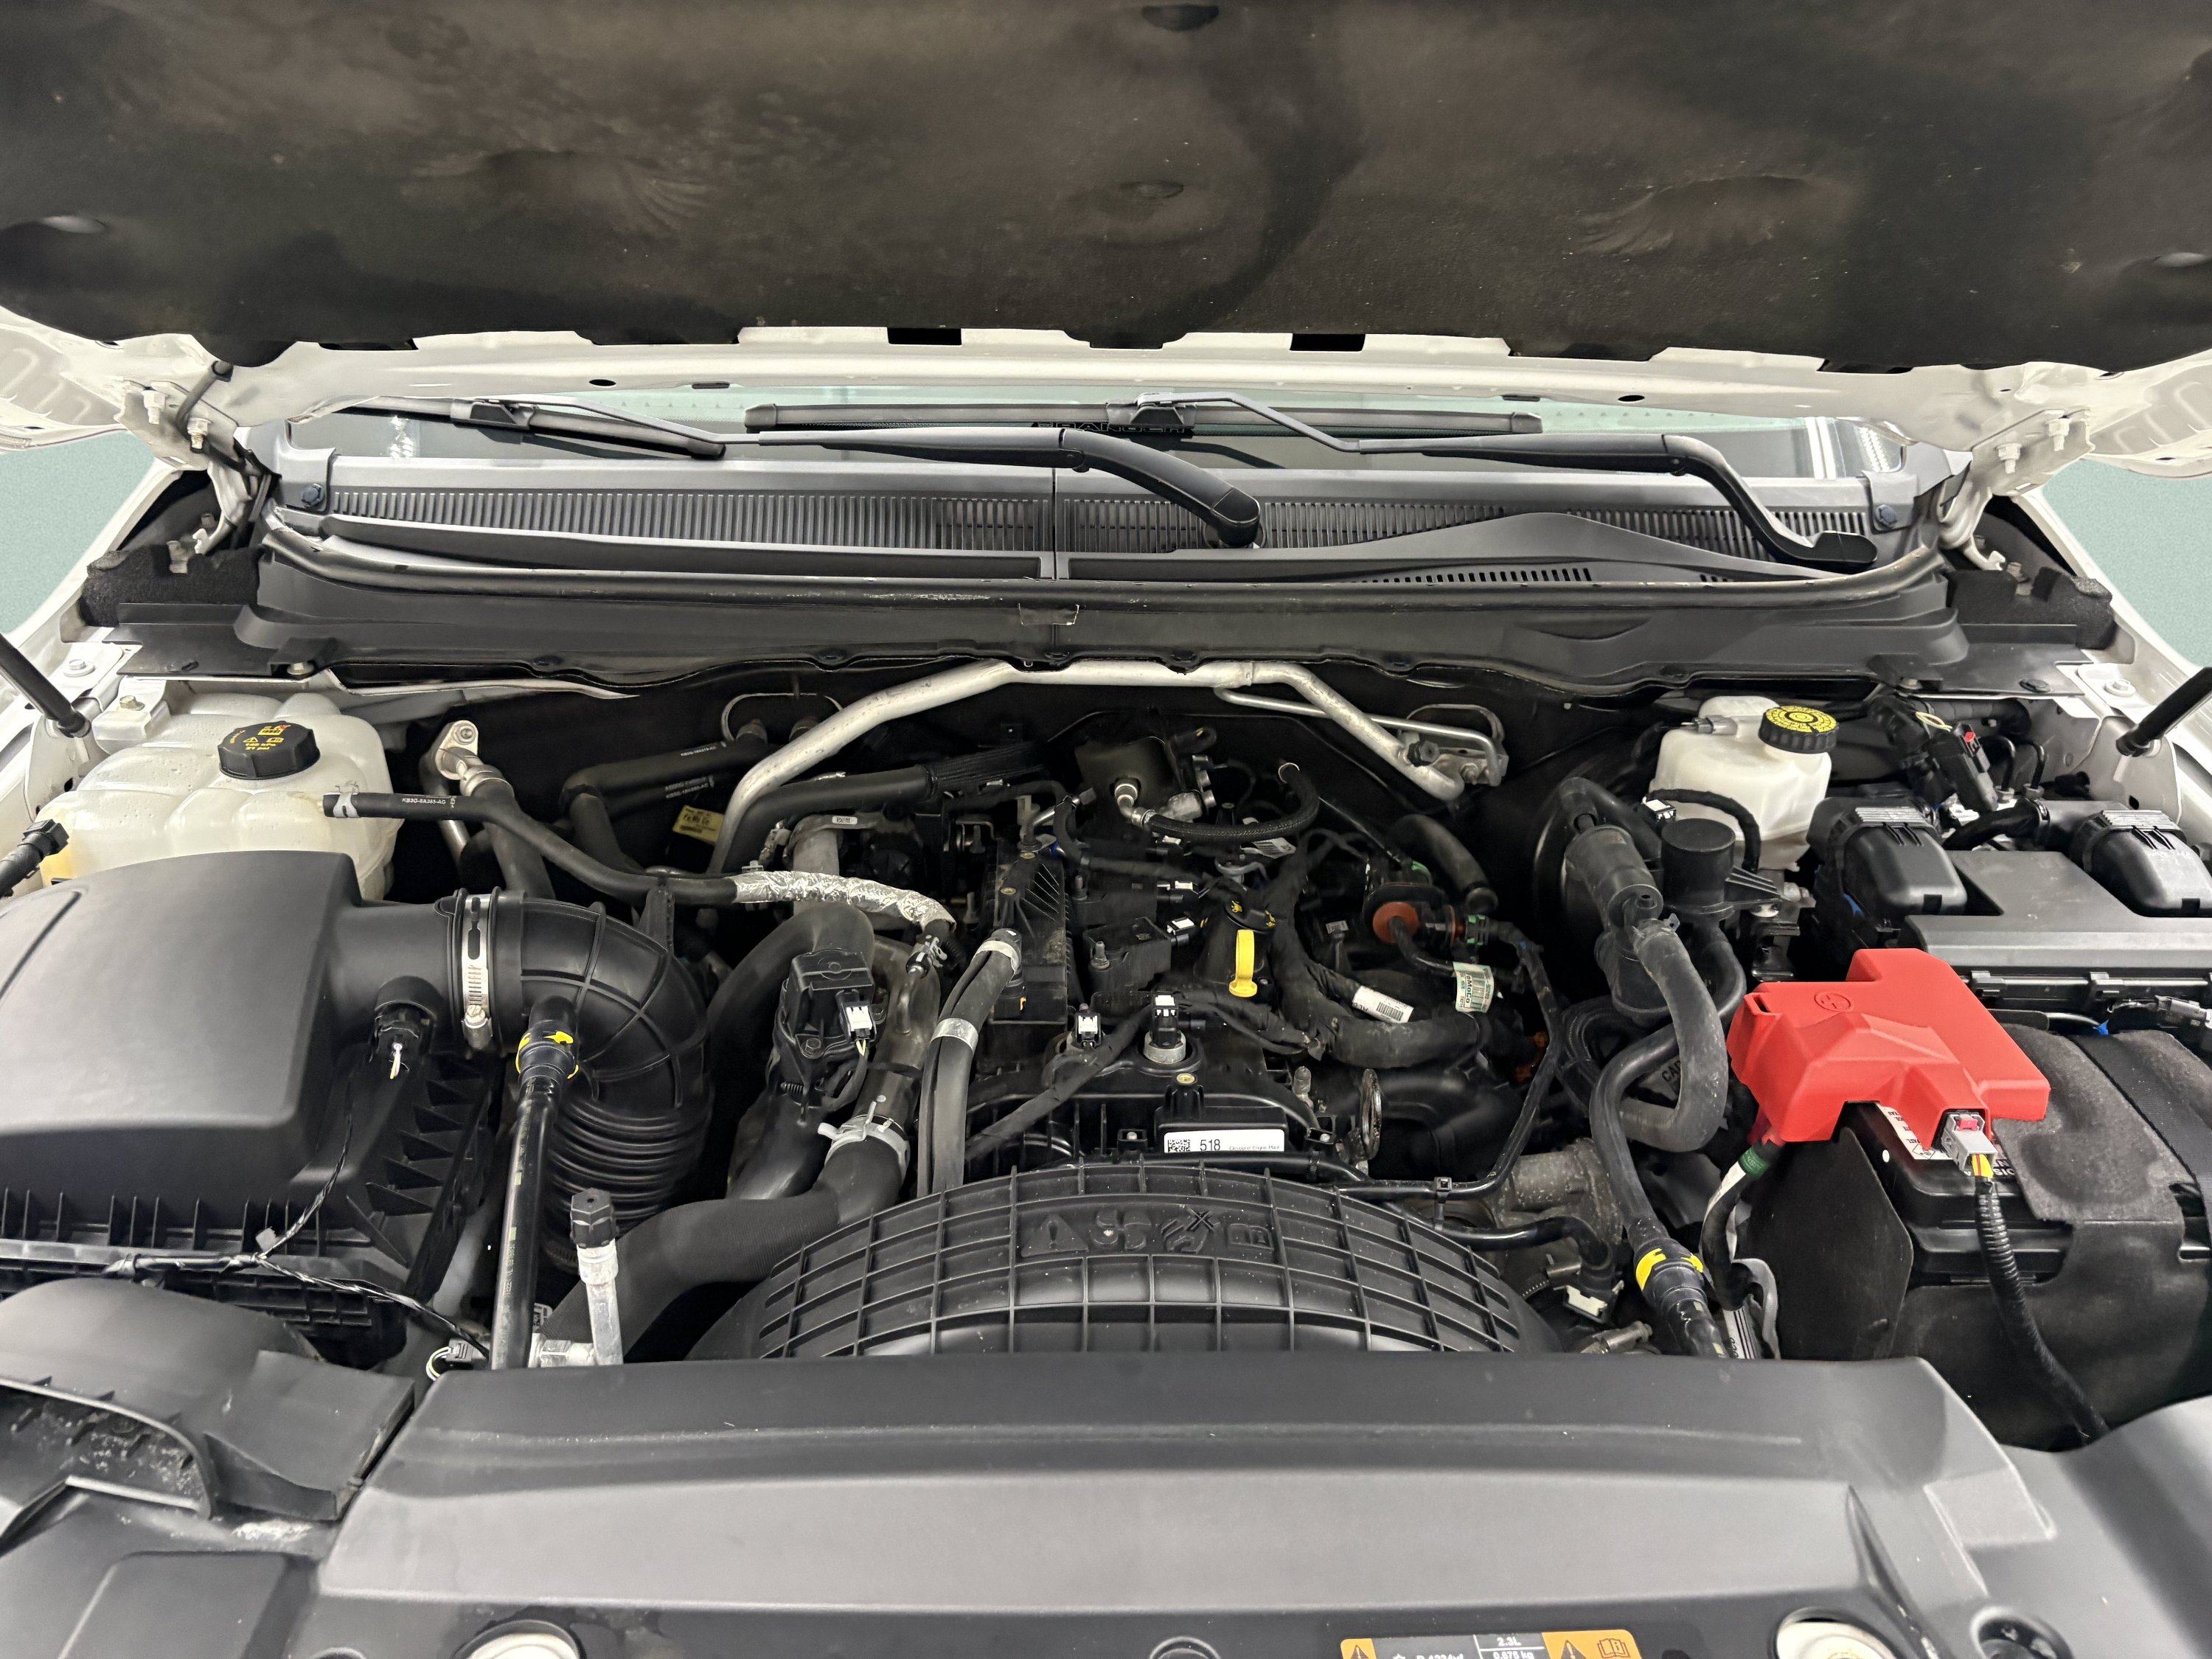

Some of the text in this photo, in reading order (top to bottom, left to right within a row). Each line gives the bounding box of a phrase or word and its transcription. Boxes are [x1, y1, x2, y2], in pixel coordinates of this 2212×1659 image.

[1200, 1138, 1221, 1152] 518
[1497, 1636, 1522, 1646] 2.3L
[1520, 1651, 1534, 1659] kg
